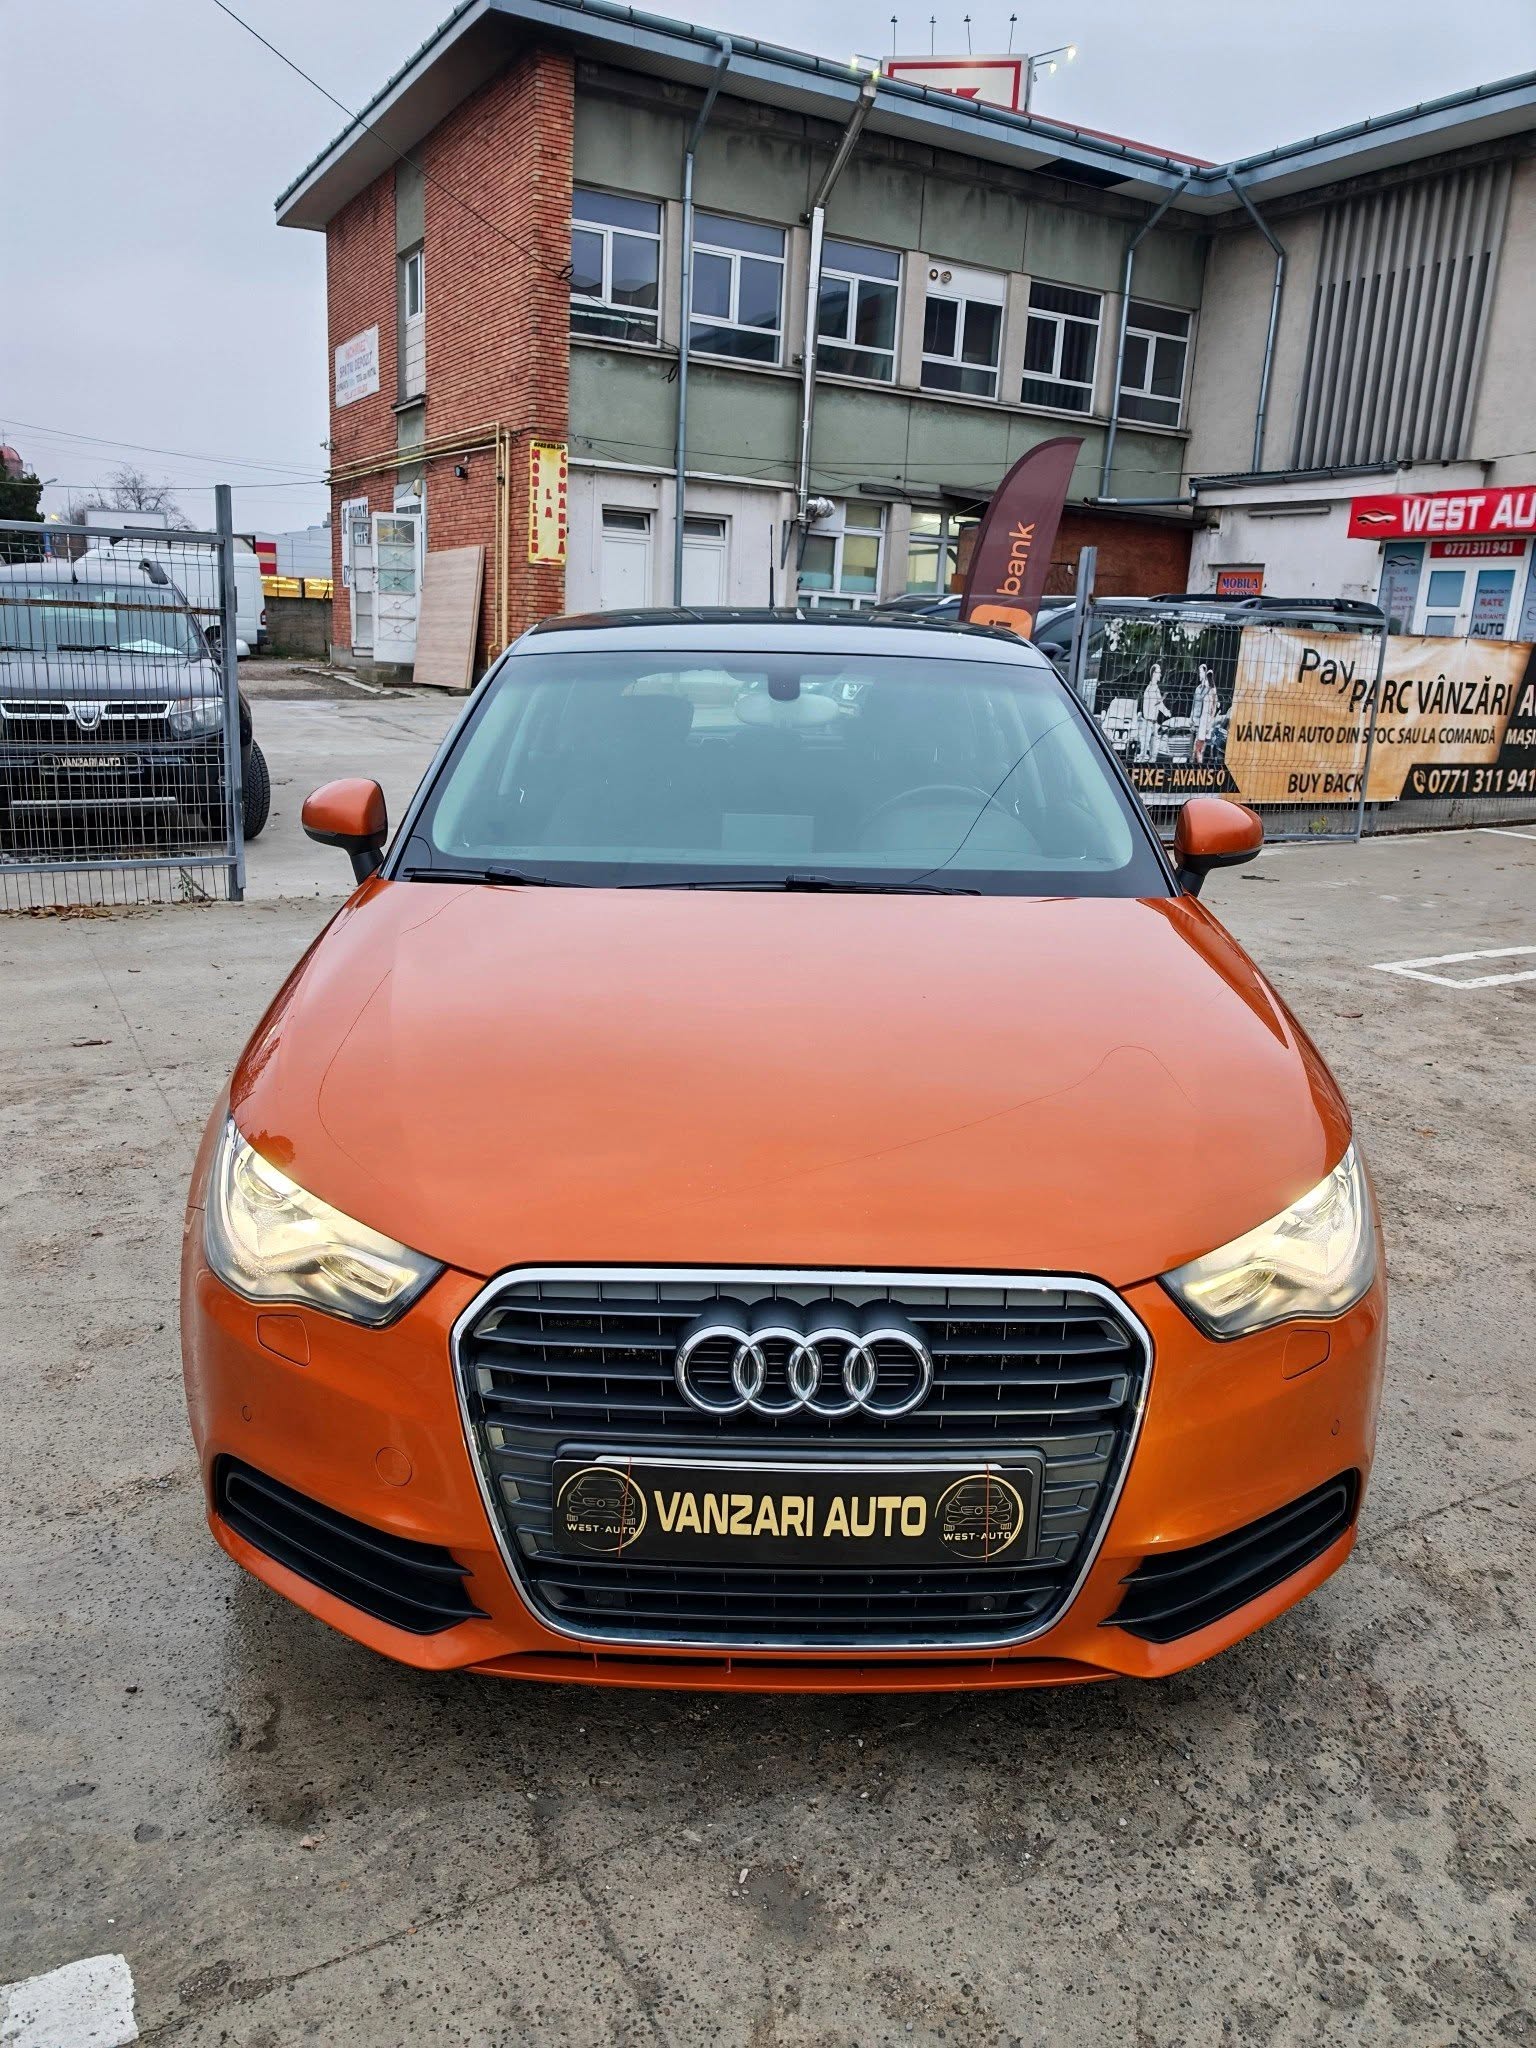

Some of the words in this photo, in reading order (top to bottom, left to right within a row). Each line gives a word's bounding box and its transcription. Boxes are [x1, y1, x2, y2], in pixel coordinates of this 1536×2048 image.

[1402, 495, 1486, 532] WEST
[996, 521, 1035, 596] bank
[1223, 578, 1259, 589] MOBILA
[1472, 622, 1505, 635] AUTO
[1298, 648, 1356, 694] Pay
[1349, 679, 1413, 714] PARC
[1418, 673, 1513, 716] VÂNZĂRI
[1518, 684, 1536, 717] A
[1236, 722, 1295, 742] VÂNZĂRI
[1297, 727, 1335, 743] AUTO
[1336, 728, 1360, 744] DIN
[1362, 727, 1396, 744] SOC
[1398, 727, 1420, 744] SAU
[1421, 727, 1436, 744] LA
[1439, 726, 1496, 744] COMANDĂ
[1287, 773, 1321, 793] BUY
[1323, 774, 1364, 793] BACK
[1428, 769, 1470, 794] 0771
[1472, 768, 1504, 793] 311
[1506, 768, 1536, 792] 941
[653, 1490, 814, 1537] VANZARI
[823, 1495, 927, 1537] AUTO
[567, 1523, 636, 1535] WEST-AUTO
[943, 1530, 1012, 1541] WEST-AUTO
